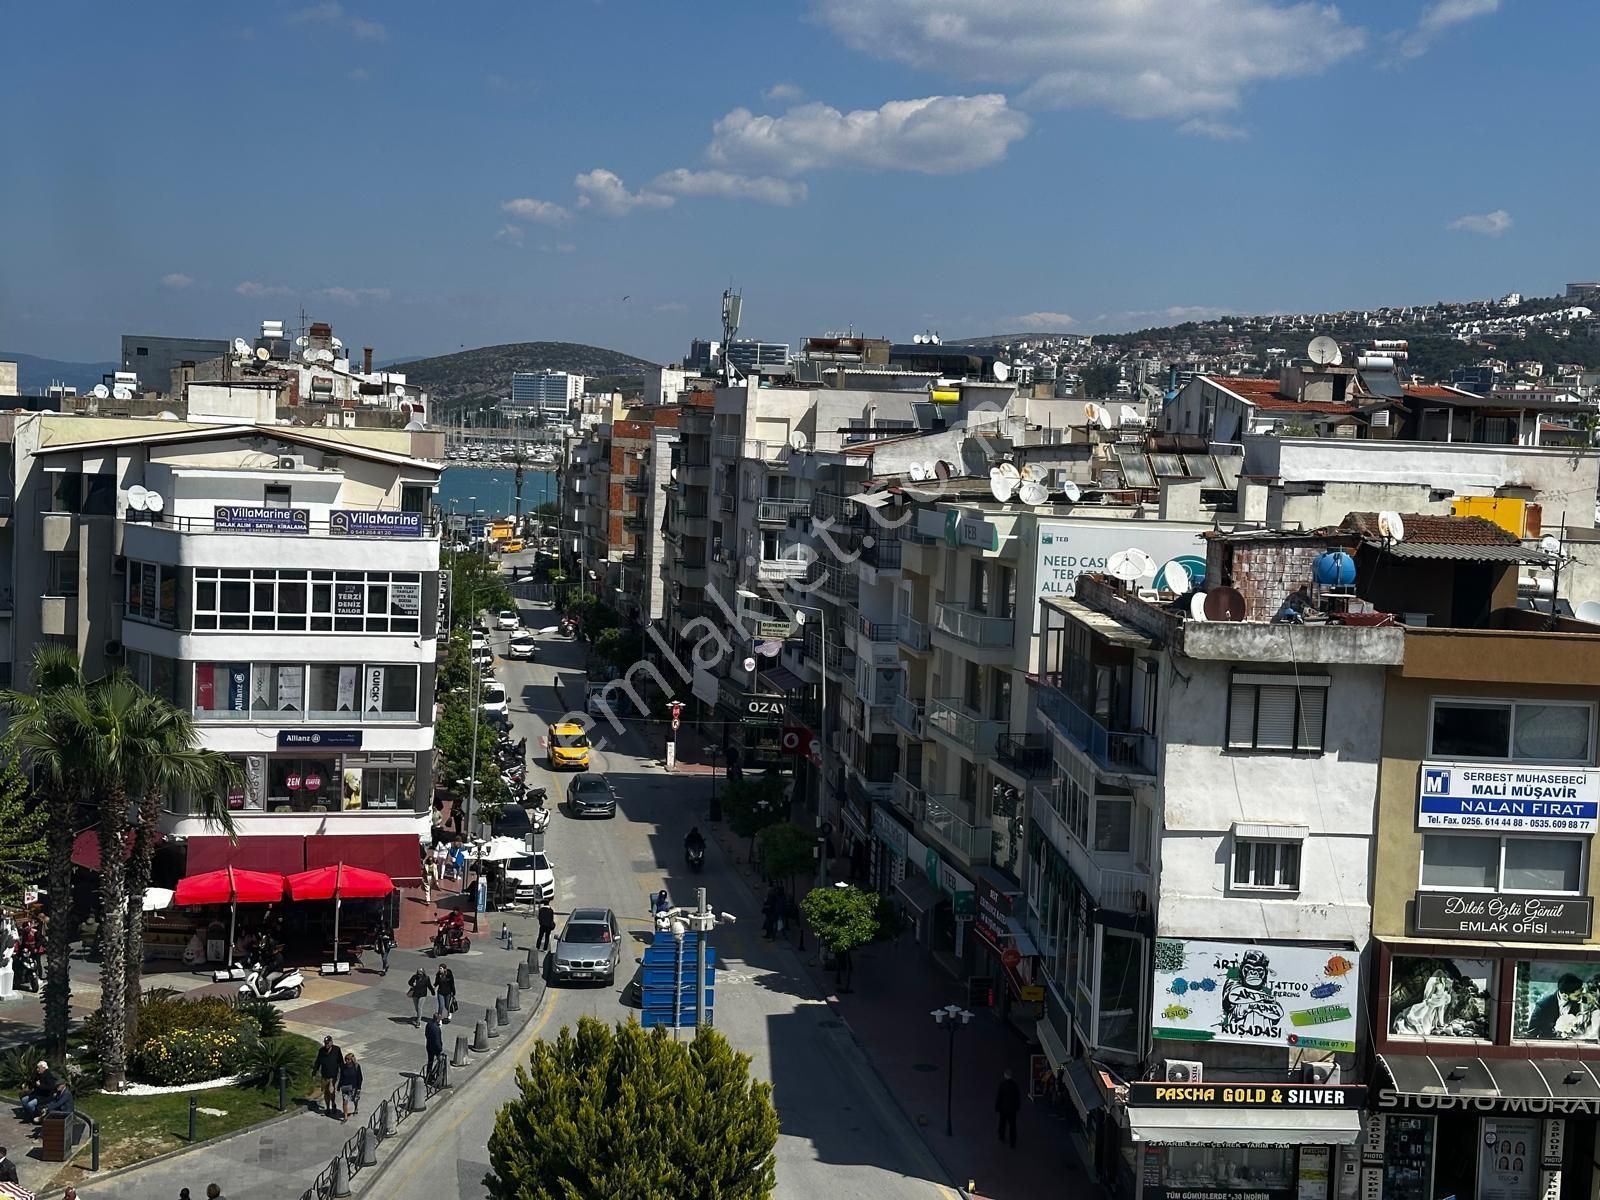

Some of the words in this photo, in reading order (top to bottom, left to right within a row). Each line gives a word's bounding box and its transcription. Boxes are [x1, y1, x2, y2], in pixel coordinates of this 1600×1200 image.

[231, 507, 291, 519] VillaMarine
[350, 512, 418, 525] VillaMarine
[964, 525, 977, 540] TEB
[1044, 556, 1077, 567] NEED
[1053, 569, 1074, 580] TEB
[1041, 582, 1063, 592] ALL
[337, 592, 361, 600] TERZİ
[372, 670, 381, 698] QUICK
[234, 684, 243, 712] Allianz
[286, 734, 311, 742] Allianz
[286, 777, 301, 787] ZEN
[1463, 772, 1514, 783] SERBEST
[1516, 774, 1587, 785] MUHASEBECİ
[1472, 782, 1507, 796] MALİ
[1511, 785, 1577, 799] MÜŞAVİR
[1461, 801, 1524, 814] NALAN
[1532, 803, 1585, 816] FIRAT
[1427, 815, 1441, 824] Tel.
[1443, 816, 1459, 825] Fax.
[1461, 817, 1483, 826] 0256.
[1485, 818, 1500, 826] 614
[1501, 818, 1512, 827] 44
[1513, 819, 1523, 827] 88
[1568, 820, 1578, 829] 88
[1579, 821, 1590, 829] 77
[944, 870, 957, 889] TEB
[1445, 897, 1485, 915] Dilek
[1523, 898, 1564, 922] Gönül
[1459, 921, 1508, 933] EMLAK
[1512, 922, 1548, 934] OFİSİ
[1269, 980, 1309, 992] TATTOO
[1273, 990, 1301, 999] PIERCING
[1161, 1007, 1194, 1019] DESIGNS
[1221, 1022, 1283, 1039] KUŞADASI
[1156, 1087, 1215, 1101] PASCHA
[1223, 1088, 1266, 1103] GOLD
[1271, 1089, 1283, 1104] &
[1287, 1089, 1345, 1105] SILVER
[1363, 1152, 1383, 1160] PHOTO
[1165, 1191, 1181, 1199] TÜM
[1182, 1191, 1227, 1200] GÜMÜŞLERDE
[1243, 1191, 1270, 1200] İNDİRİM
